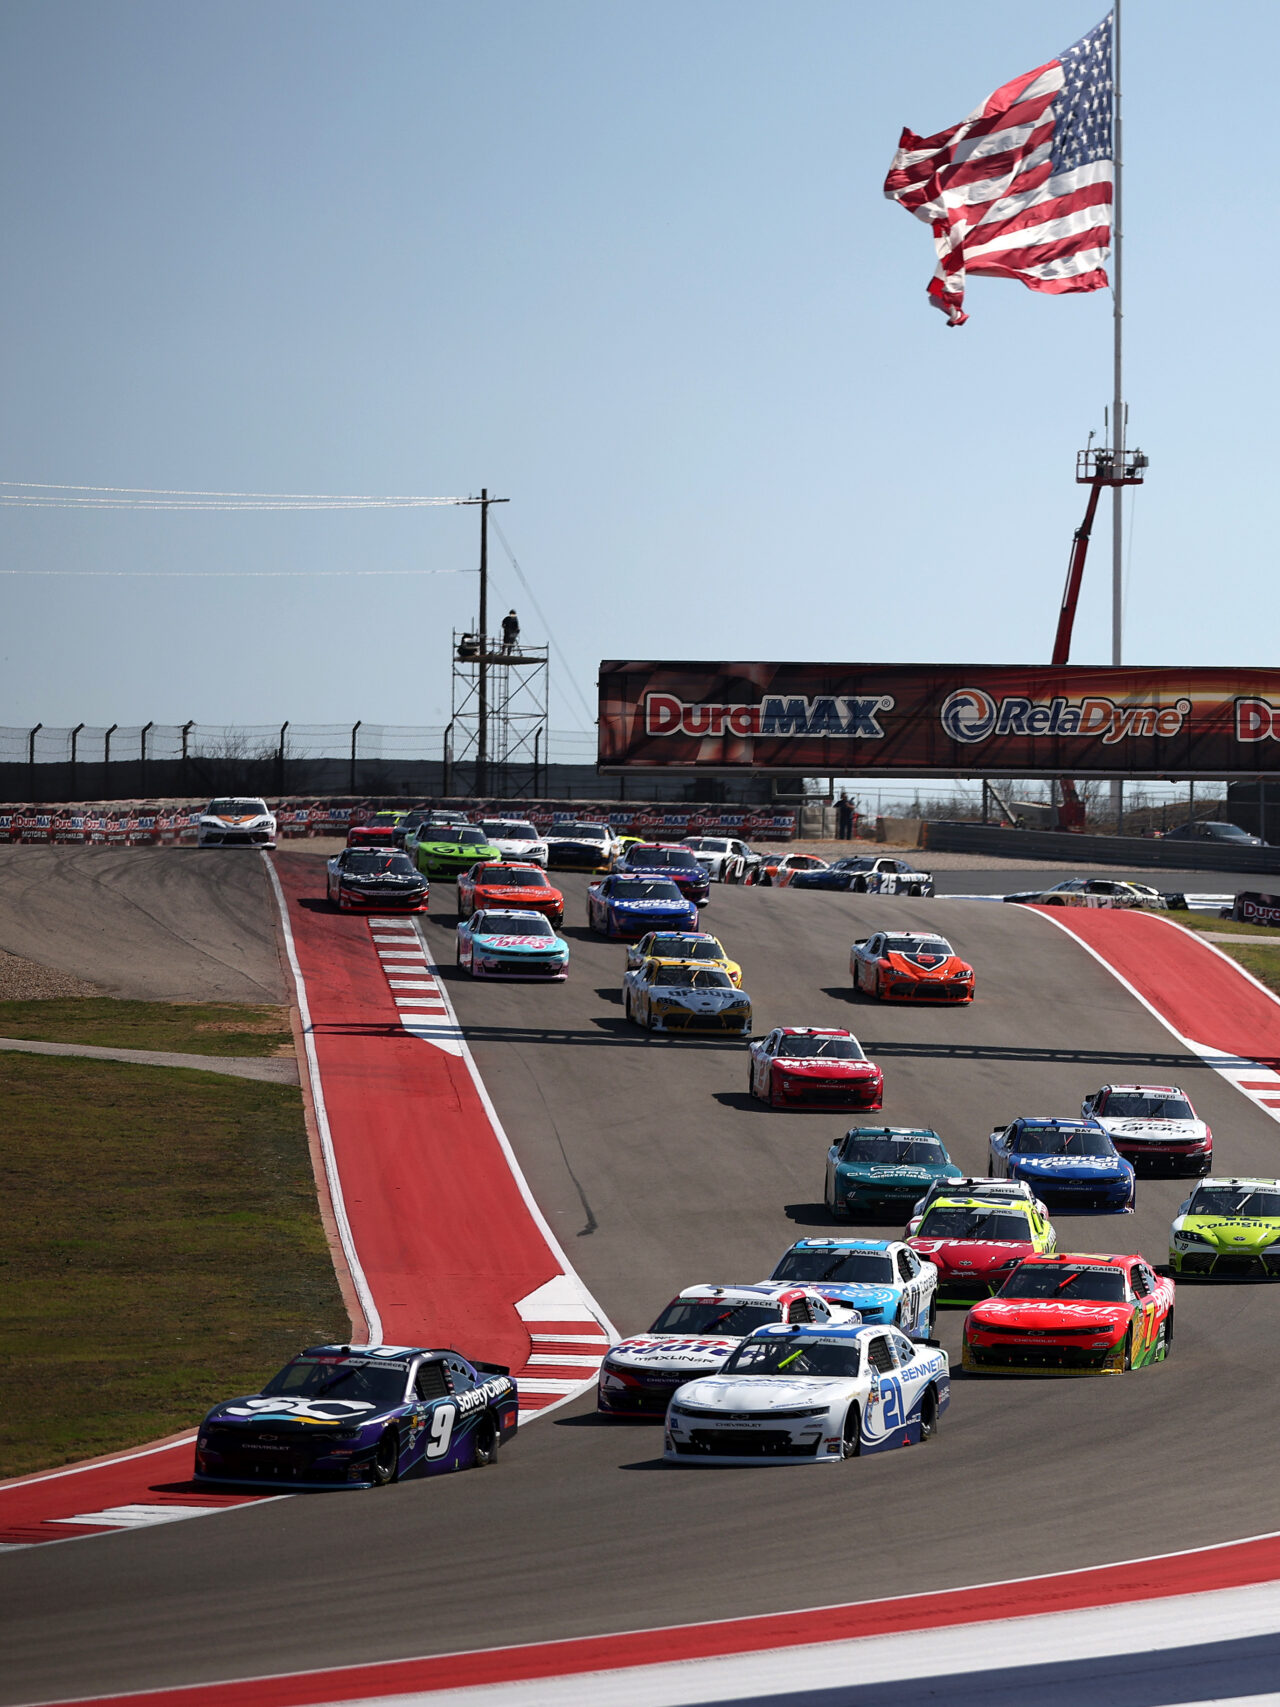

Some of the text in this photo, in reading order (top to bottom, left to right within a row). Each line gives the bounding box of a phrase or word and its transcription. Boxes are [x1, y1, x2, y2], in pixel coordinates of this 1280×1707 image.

[640, 814, 691, 826] DuraMAX
[696, 815, 745, 827] DuraMAX
[879, 873, 897, 894] 26
[1020, 1155, 1119, 1166] Hendrick
[1075, 1264, 1120, 1272] ALLGAIER
[971, 1303, 1129, 1315] BRANDT
[1145, 1300, 1155, 1350] 7
[901, 1356, 942, 1383] BENNETT
[880, 1376, 906, 1430] 21
[425, 1404, 456, 1458] 9
